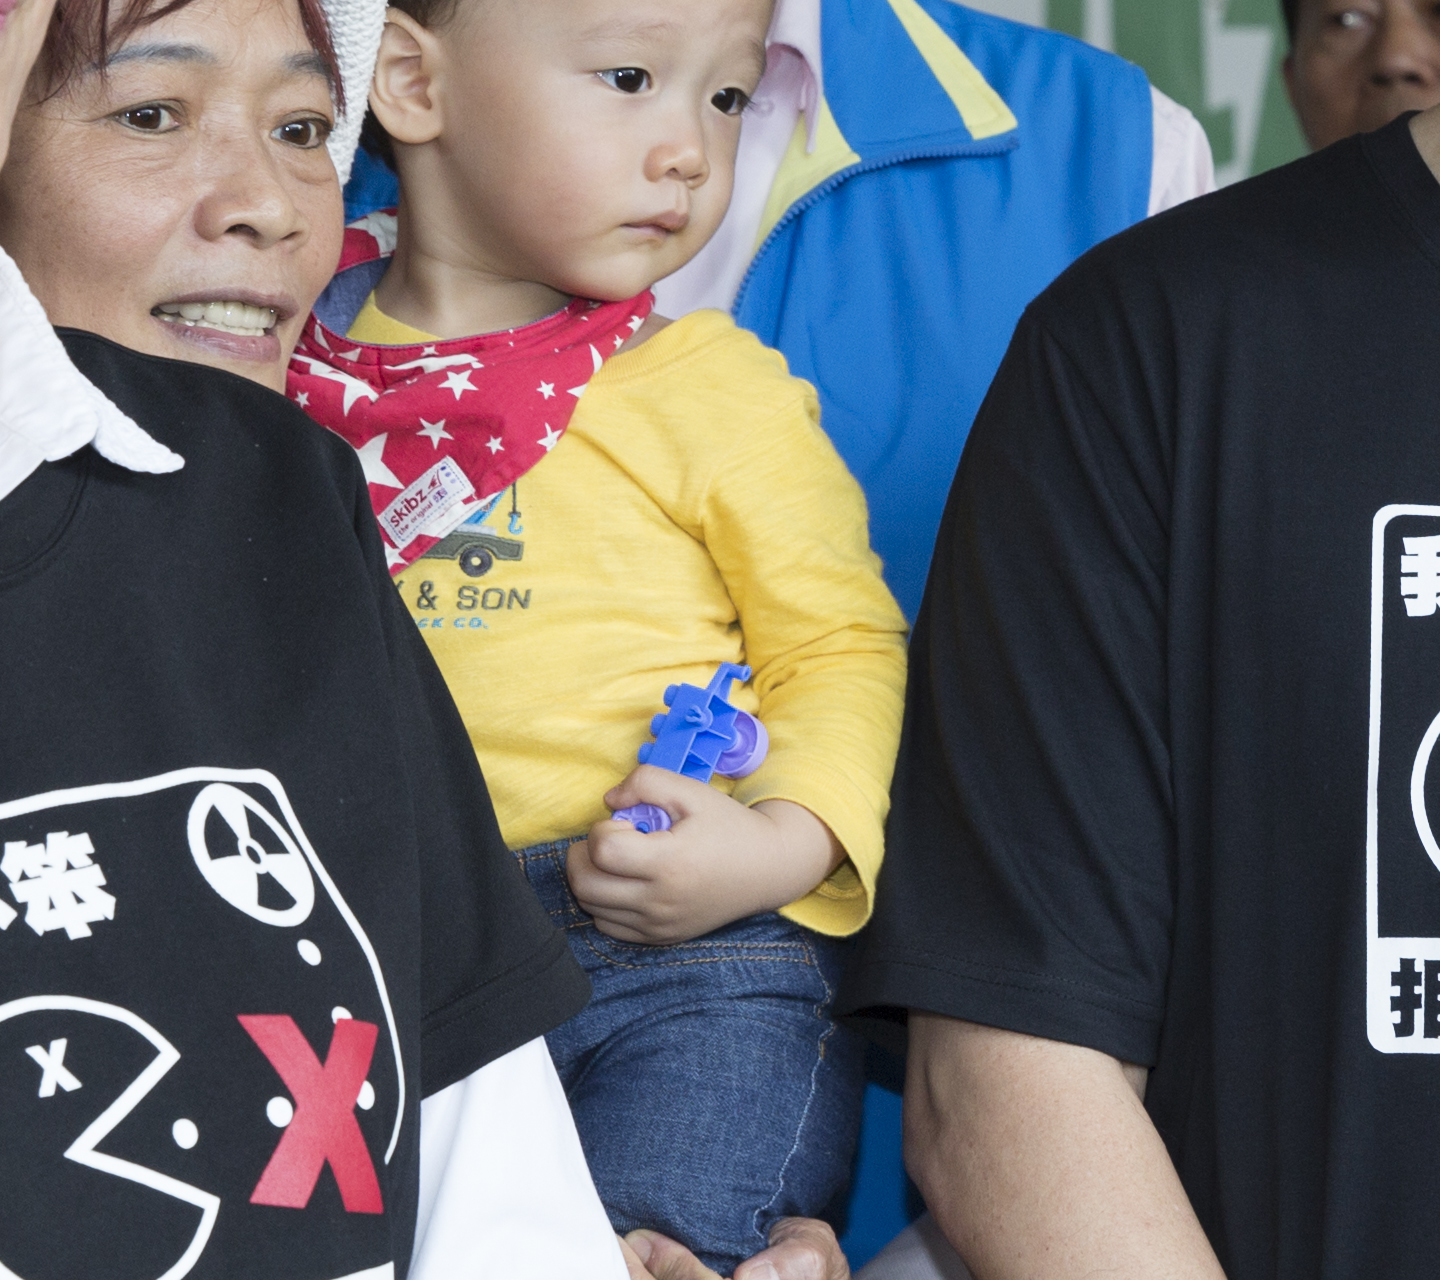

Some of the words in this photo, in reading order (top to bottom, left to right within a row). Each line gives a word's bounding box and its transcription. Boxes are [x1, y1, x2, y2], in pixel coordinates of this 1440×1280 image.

[389, 488, 428, 528] skibz
[398, 522, 410, 537] the
[410, 501, 435, 525] original
[416, 580, 439, 610] &
[456, 585, 533, 611] SON
